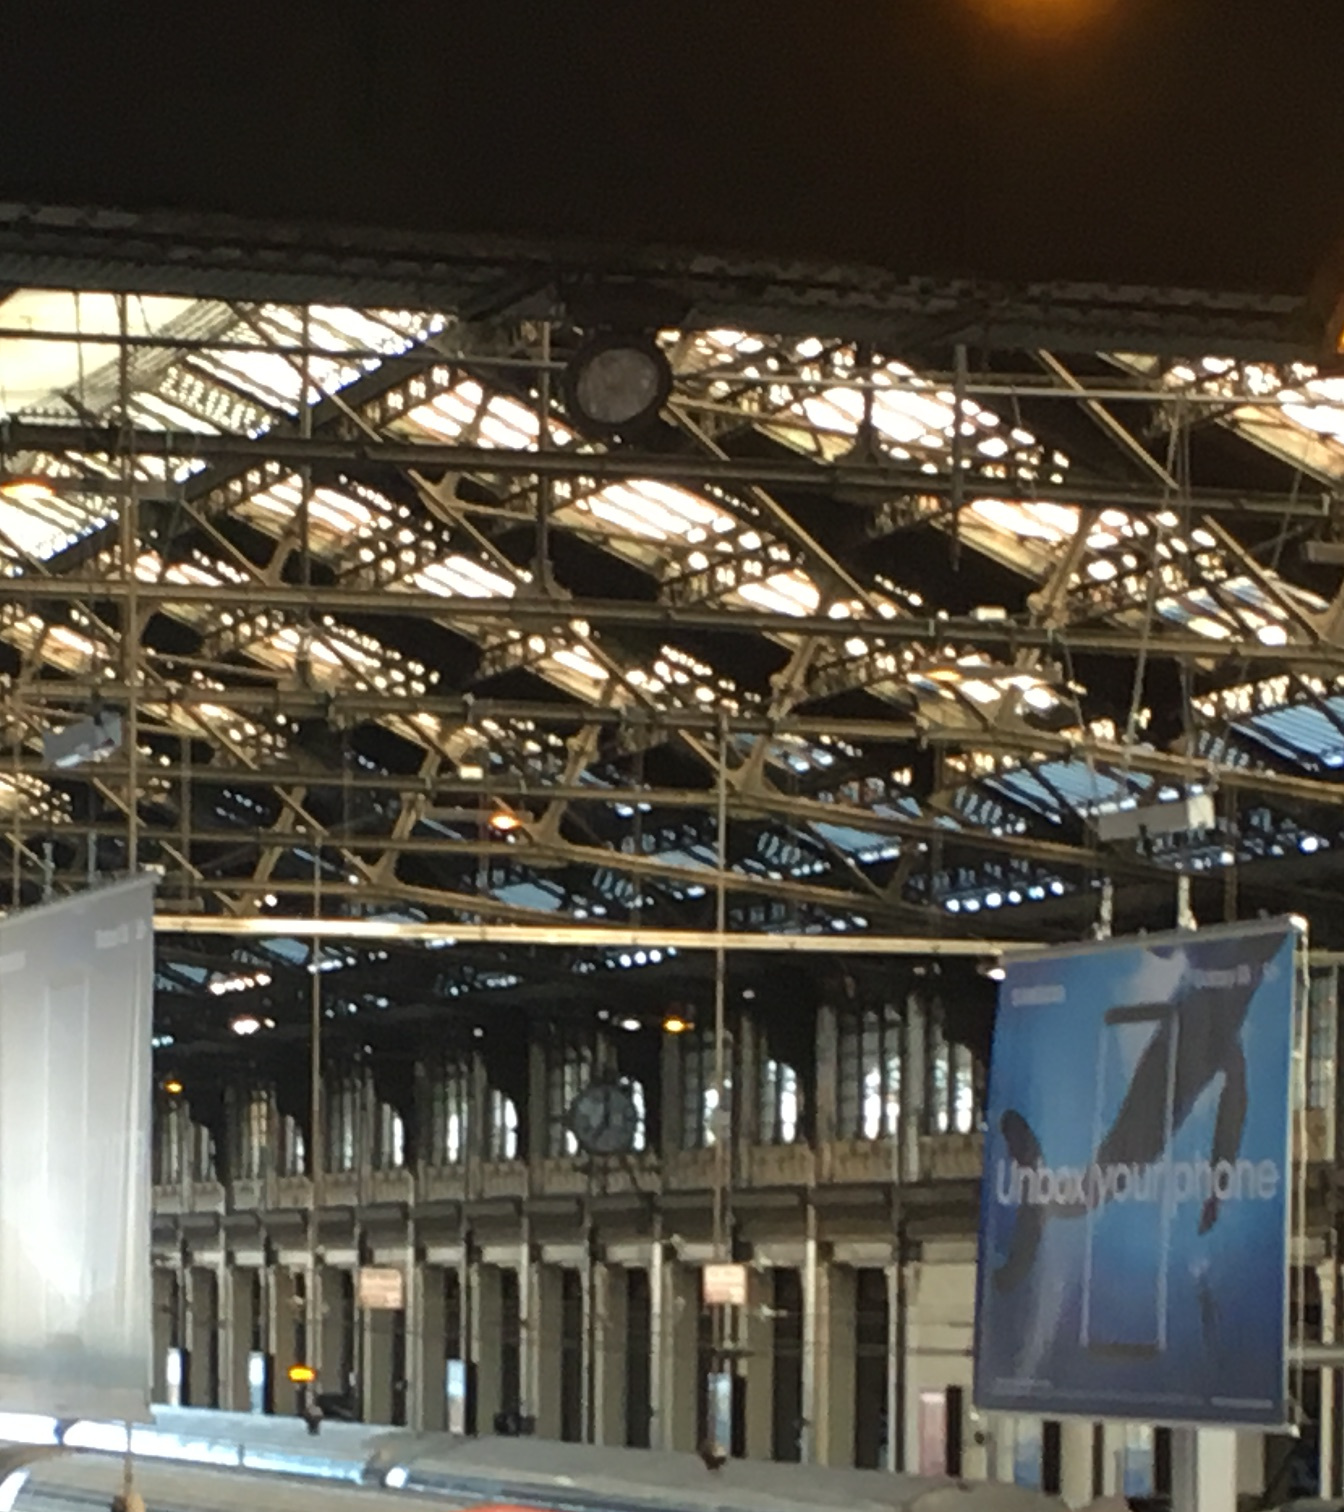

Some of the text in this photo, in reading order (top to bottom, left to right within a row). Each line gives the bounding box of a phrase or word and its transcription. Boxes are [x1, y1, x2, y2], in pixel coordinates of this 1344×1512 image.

[995, 1153, 1281, 1217] Unbox your phone
